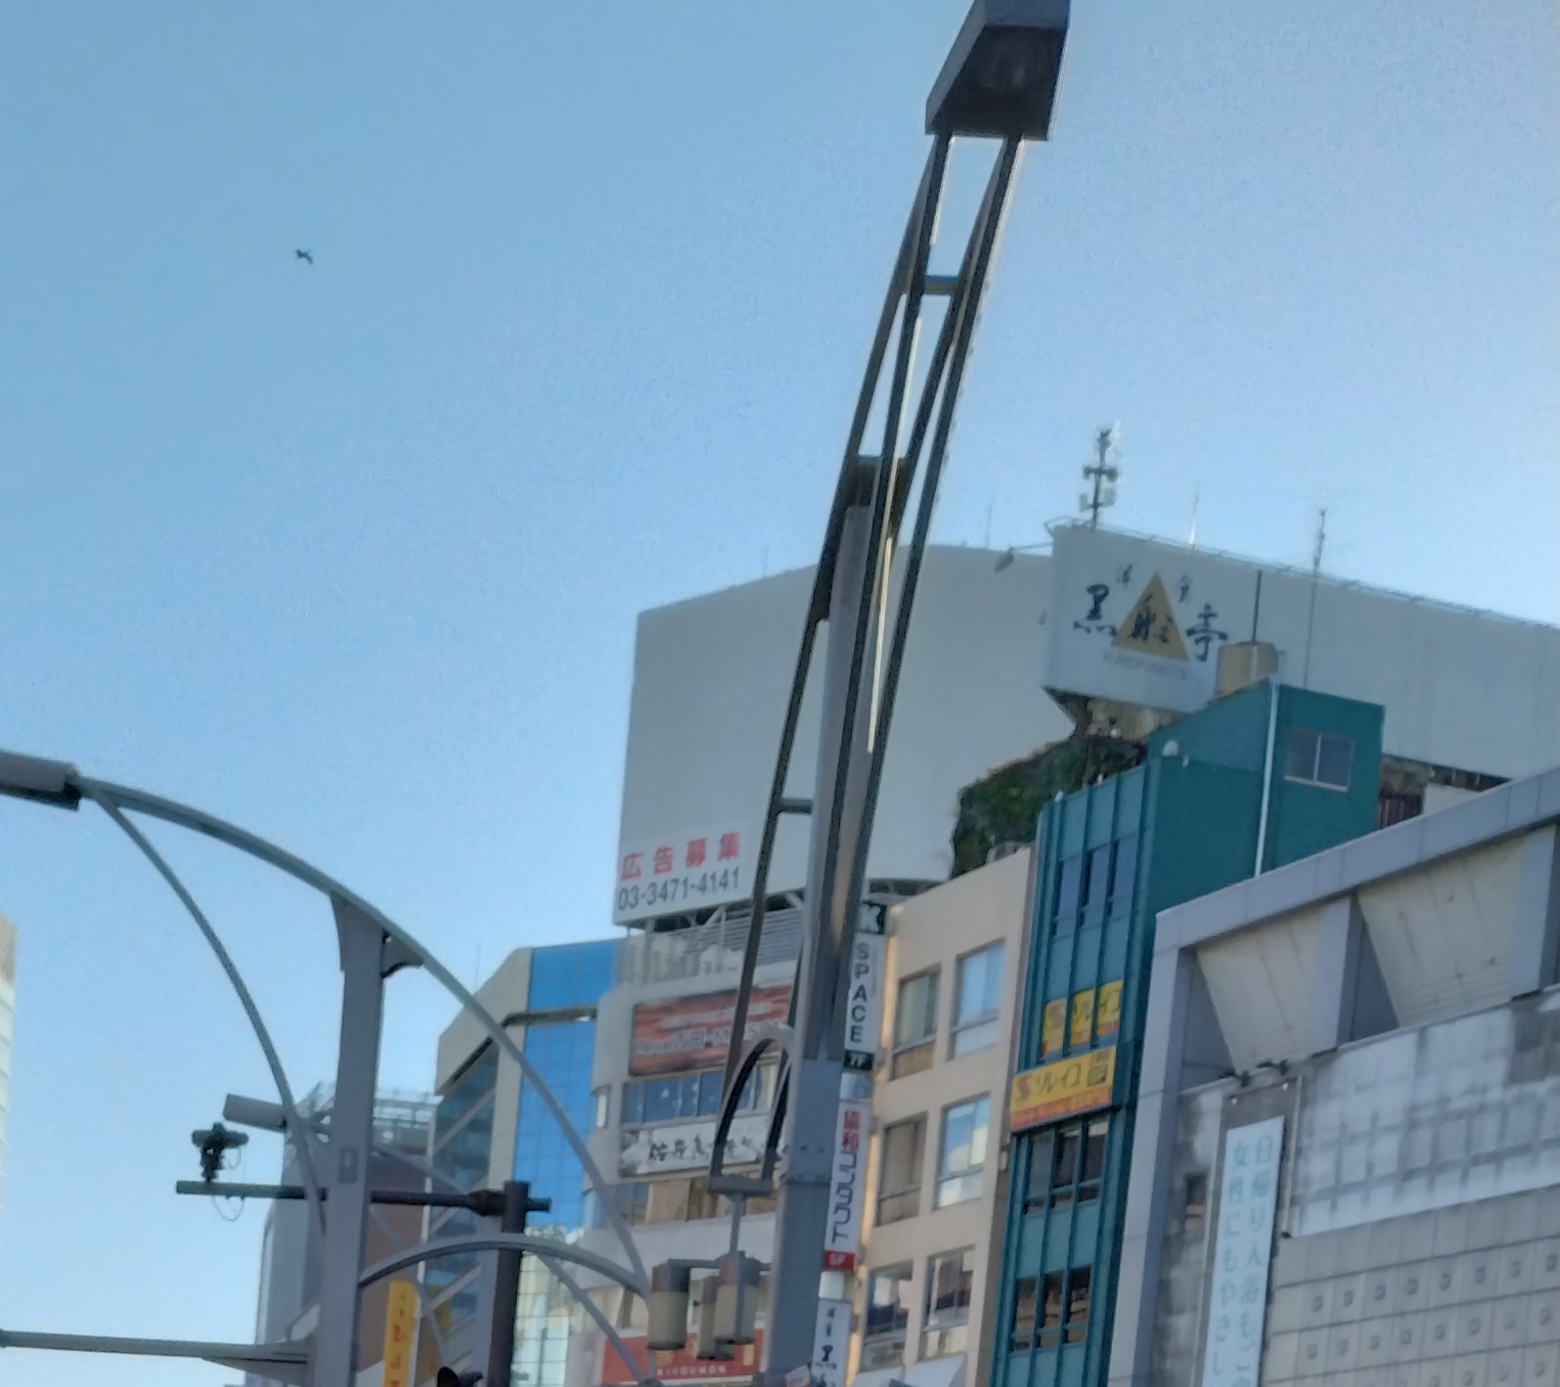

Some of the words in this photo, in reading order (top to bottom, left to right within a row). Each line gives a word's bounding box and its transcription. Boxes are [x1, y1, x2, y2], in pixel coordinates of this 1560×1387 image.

[621, 831, 740, 880] 広告募集
[618, 866, 740, 911] 03-3471-4141
[851, 942, 872, 1043] SPACE
